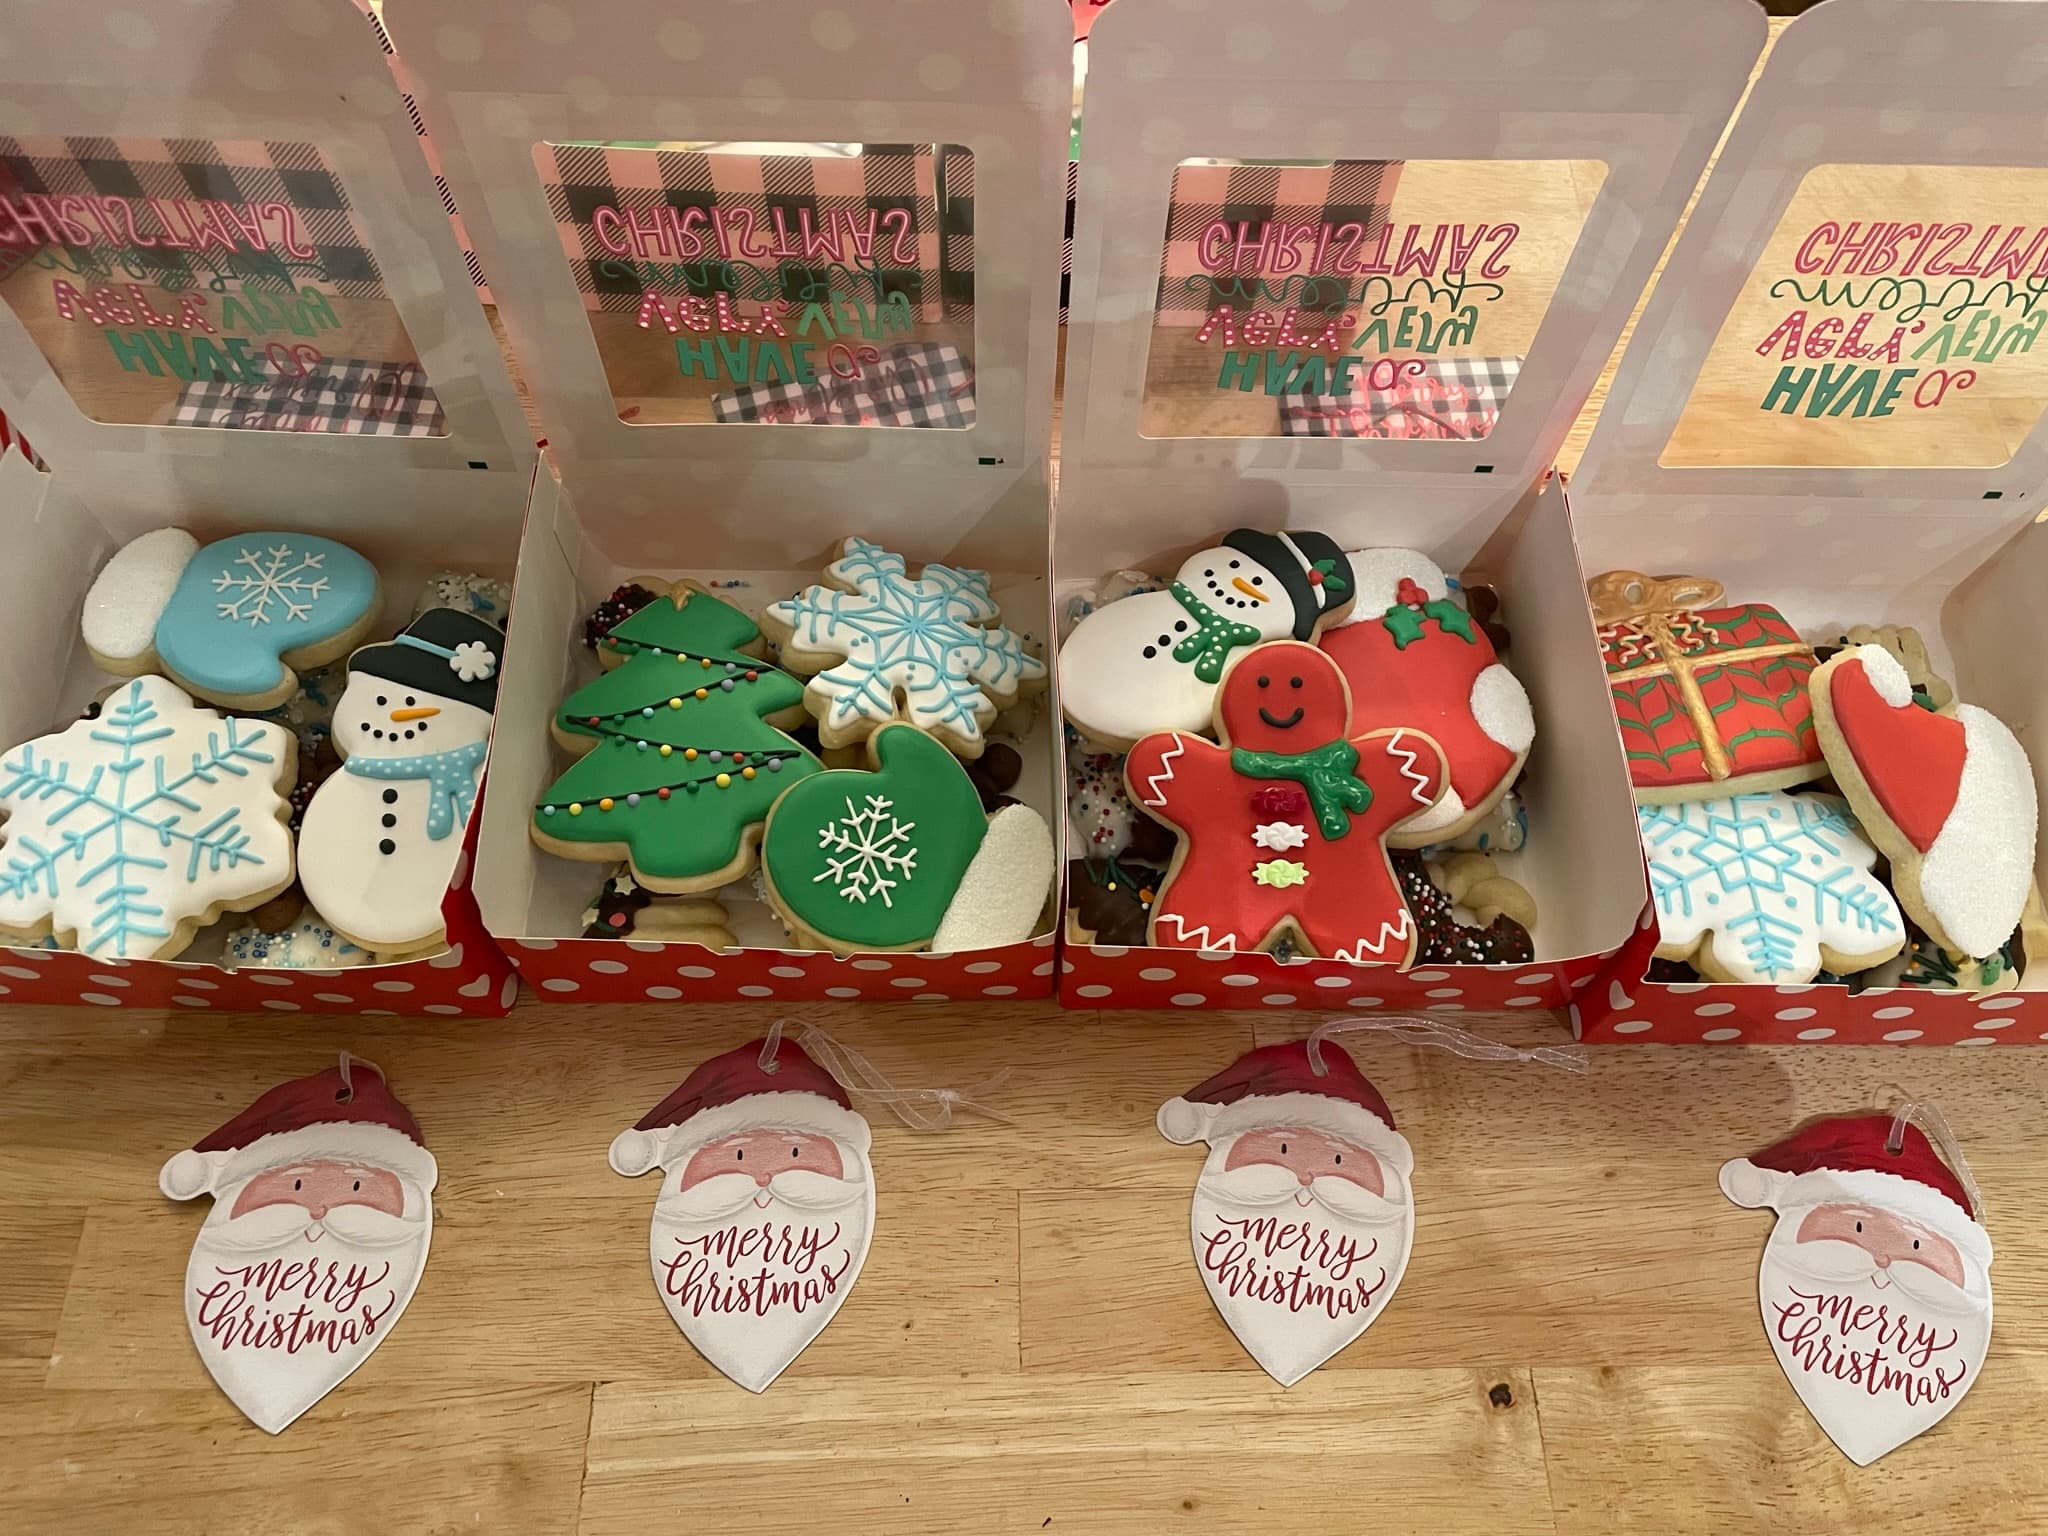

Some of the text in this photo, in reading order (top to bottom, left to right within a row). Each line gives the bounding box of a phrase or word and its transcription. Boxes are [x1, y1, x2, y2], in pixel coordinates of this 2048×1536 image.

[660, 1249, 850, 1317] Christmas
[1200, 1229, 1386, 1319] Christmas
[196, 1280, 395, 1354] Christmas
[1772, 1302, 1966, 1406] Christmas
